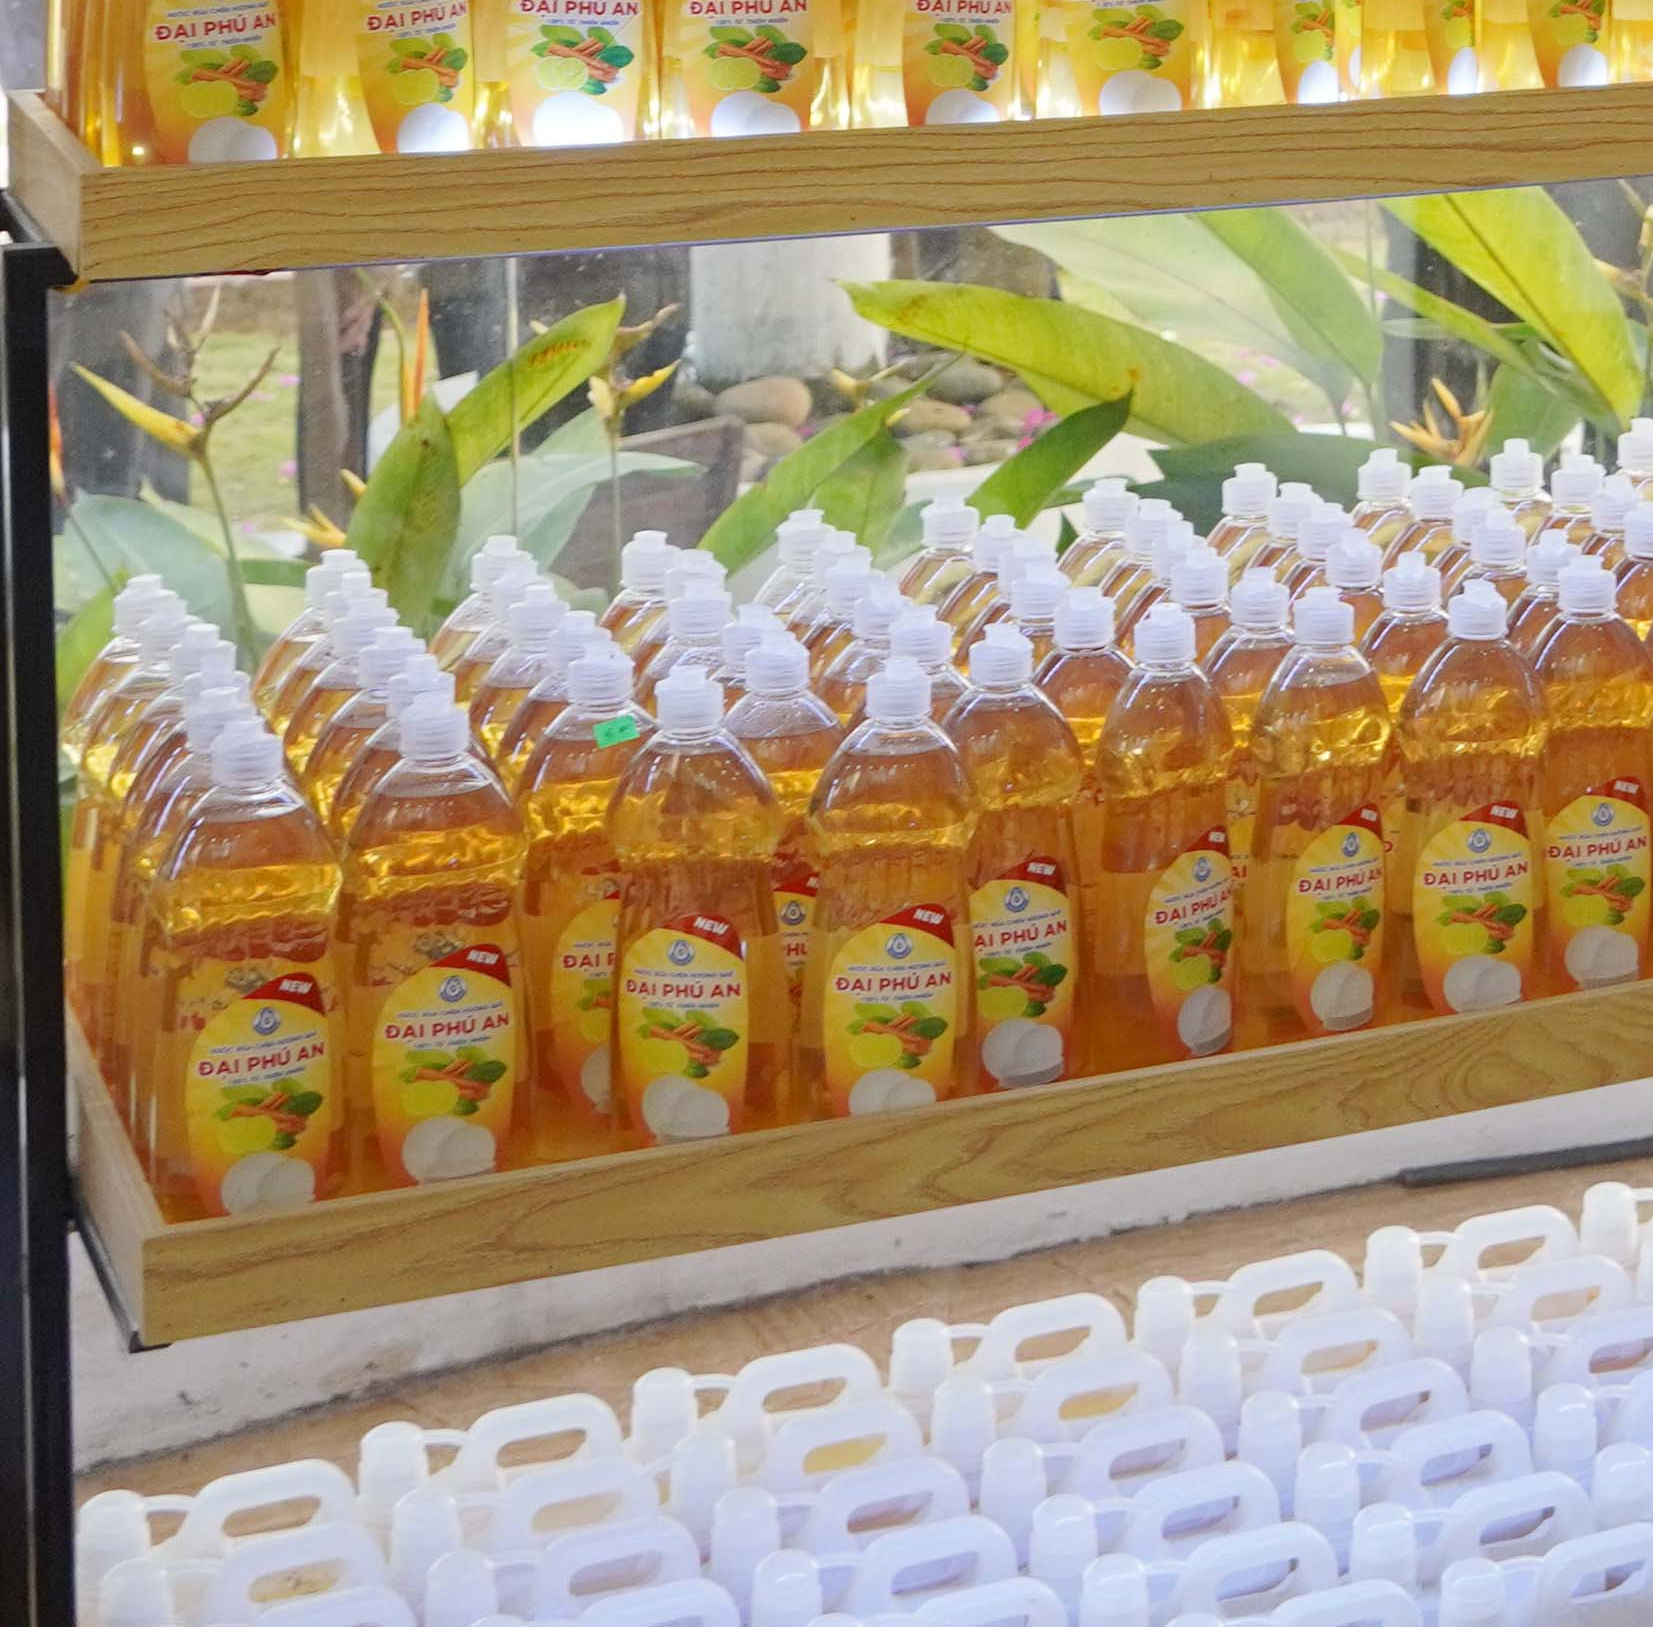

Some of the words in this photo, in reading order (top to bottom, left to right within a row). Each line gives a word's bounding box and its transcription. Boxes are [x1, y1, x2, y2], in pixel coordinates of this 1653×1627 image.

[913, 908, 945, 925] NEW
[693, 916, 730, 935] NEW
[466, 949, 500, 965] NEW
[279, 979, 313, 994] NEW
